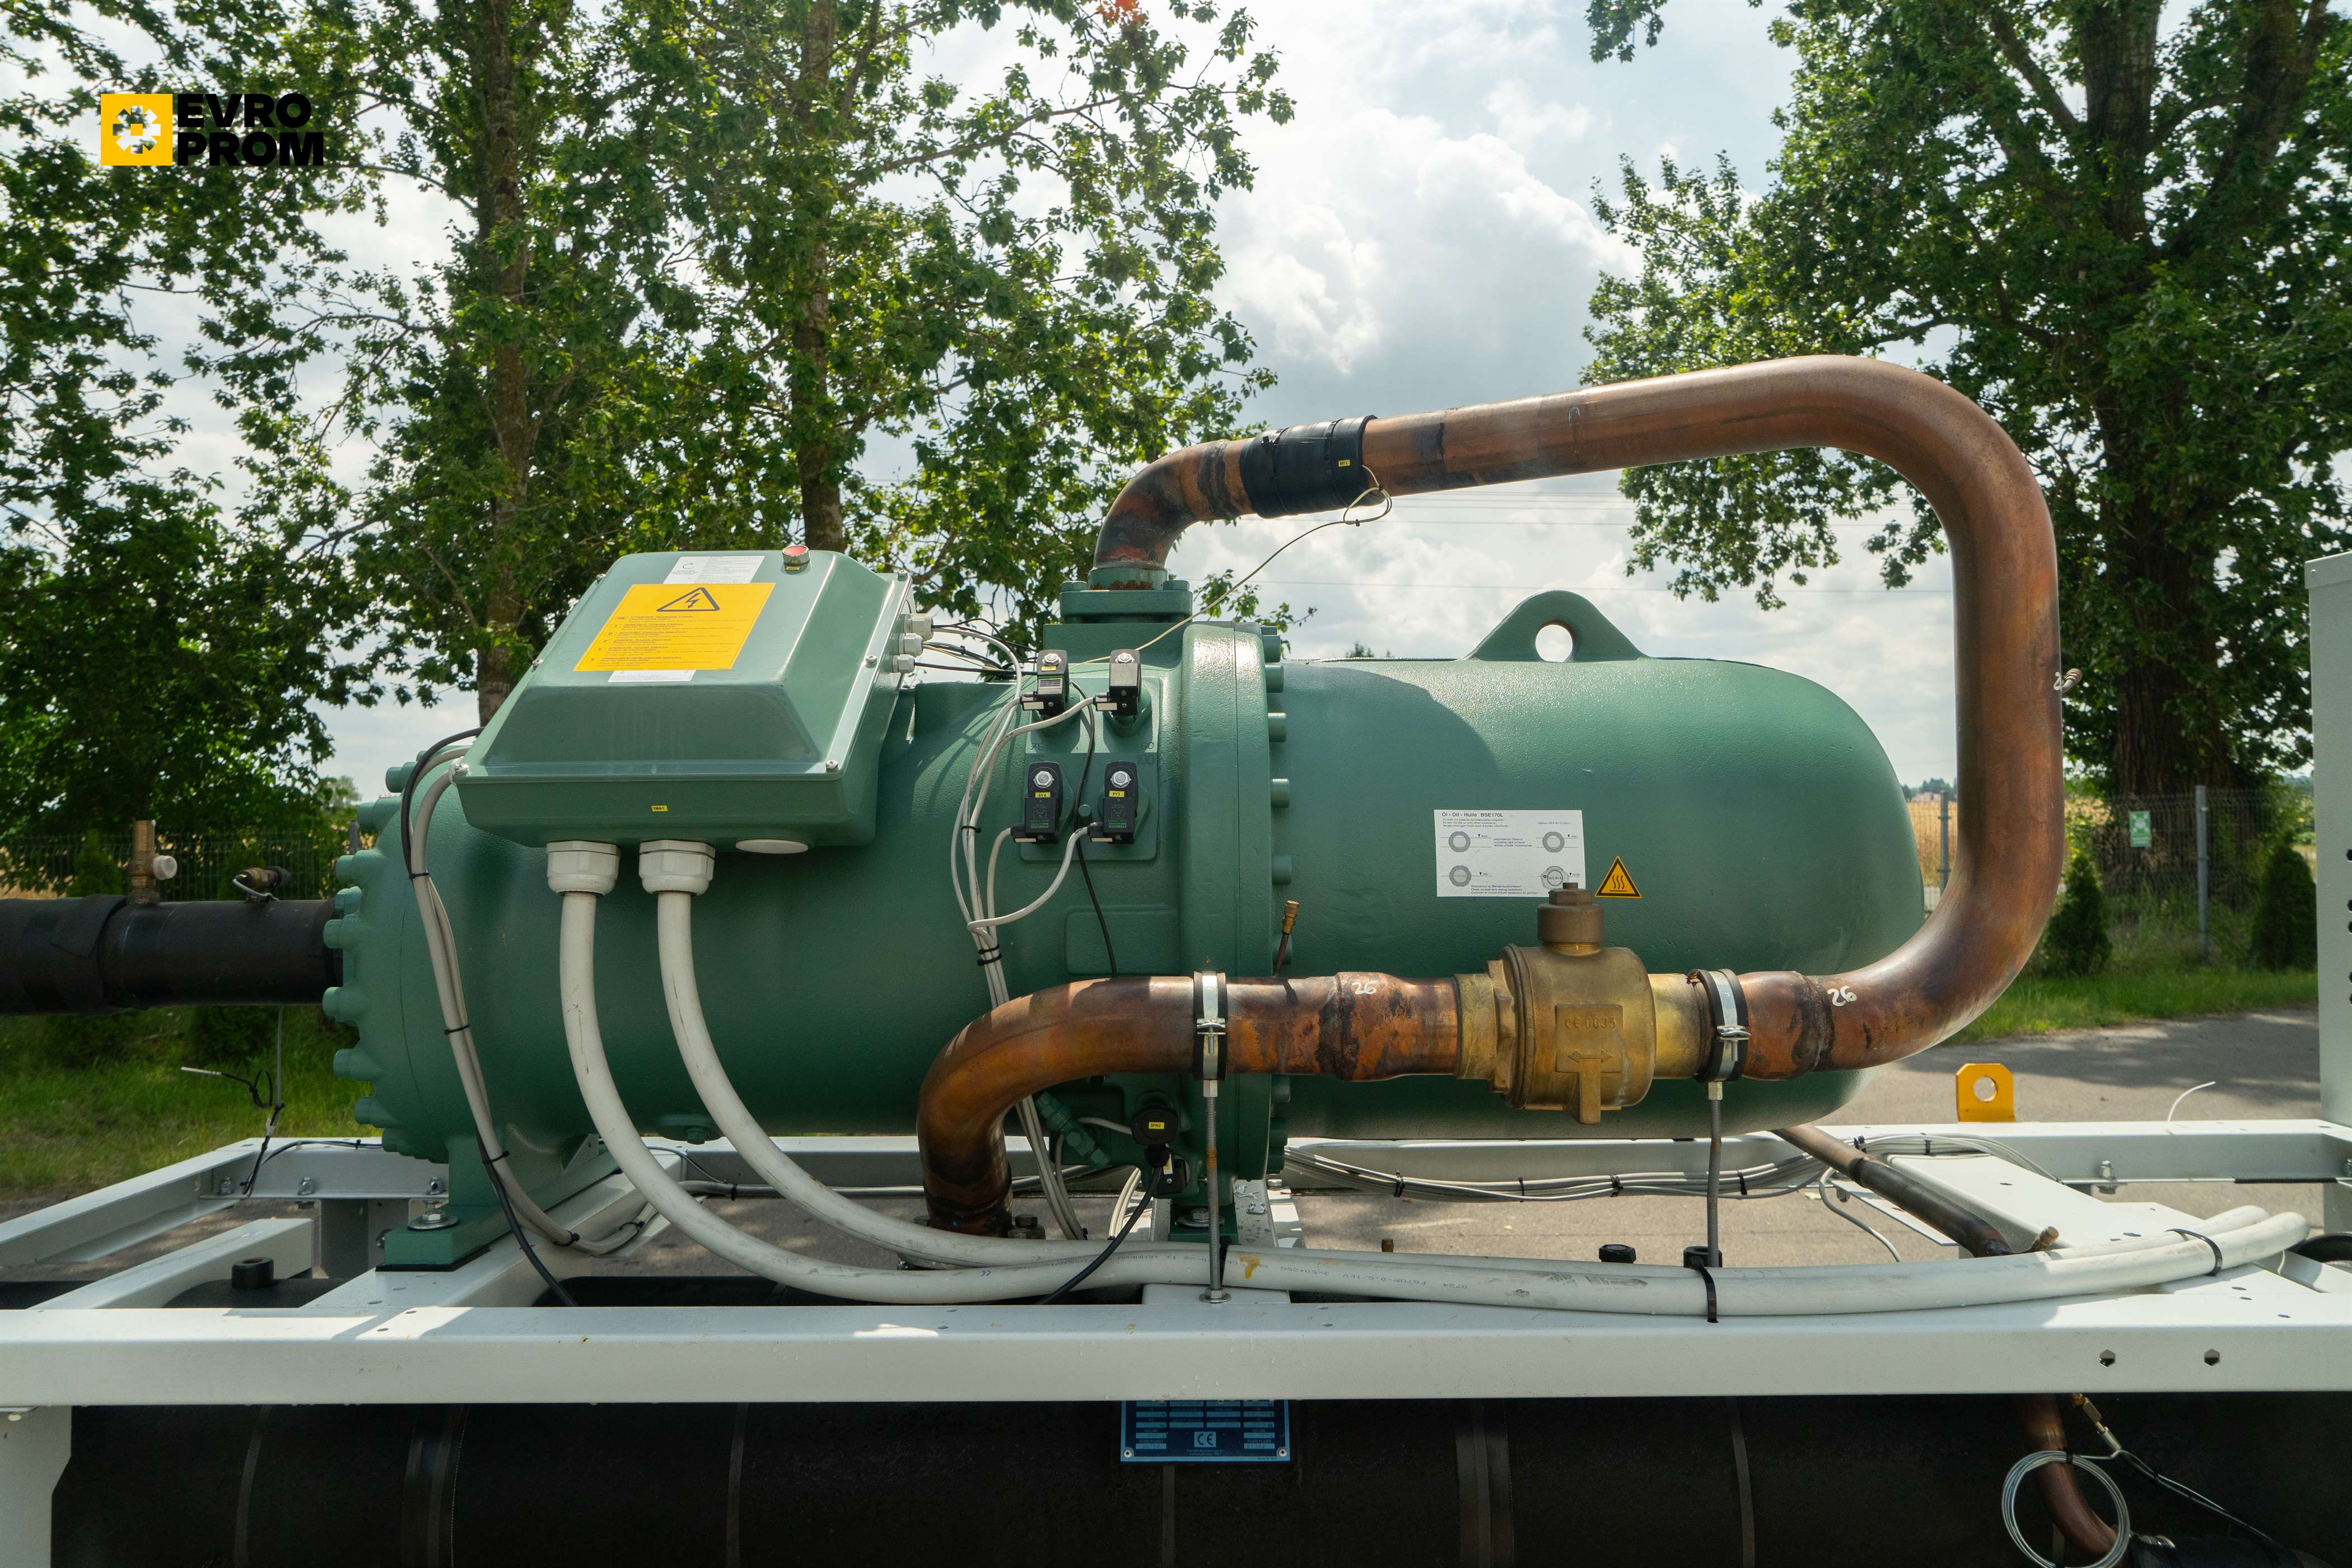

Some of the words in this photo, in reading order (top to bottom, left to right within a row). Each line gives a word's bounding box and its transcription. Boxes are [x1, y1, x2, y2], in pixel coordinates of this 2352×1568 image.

[1352, 980, 1378, 995] 26
[1827, 985, 1858, 1007] 26
[1585, 1016, 1617, 1029] 0035
